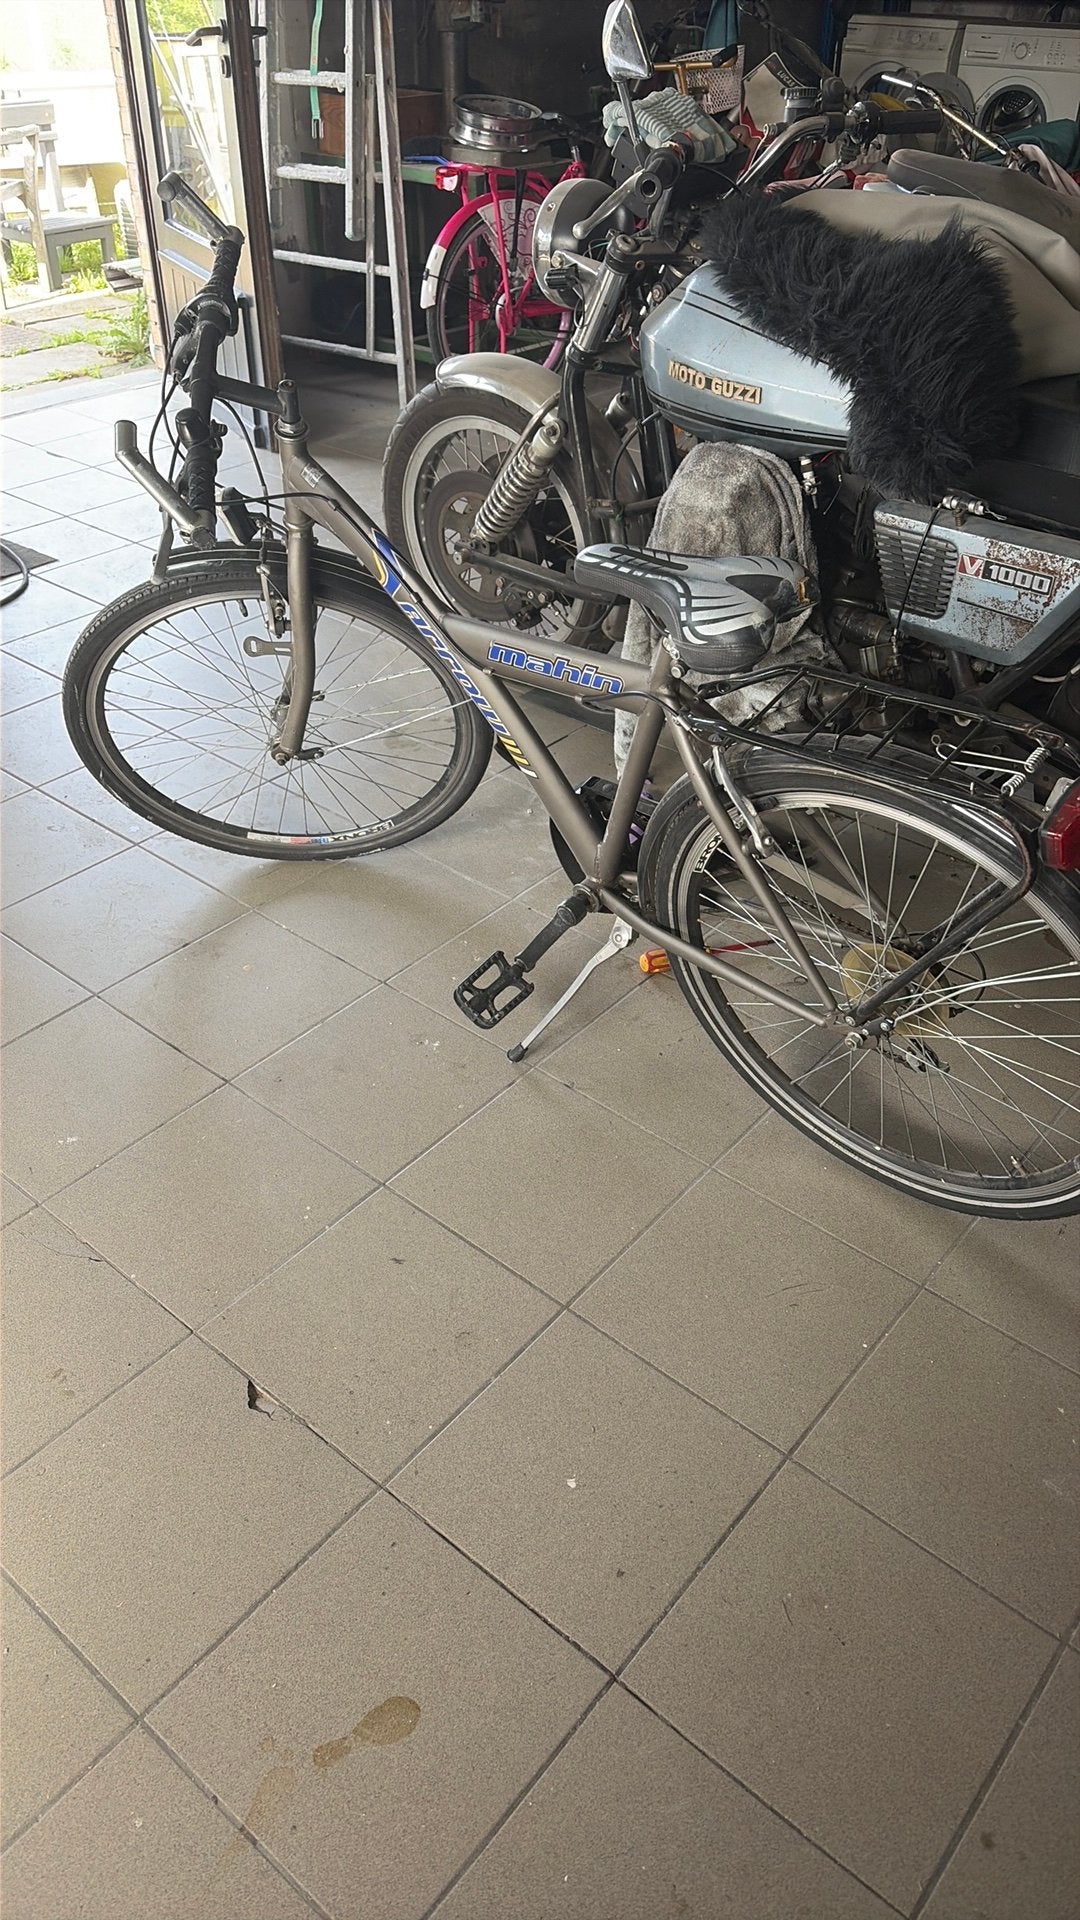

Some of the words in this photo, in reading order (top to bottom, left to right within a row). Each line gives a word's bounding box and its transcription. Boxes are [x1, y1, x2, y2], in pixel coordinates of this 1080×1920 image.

[668, 360, 706, 391] MOTO
[711, 378, 761, 405] GUZZI
[962, 554, 984, 575] V
[988, 564, 1051, 593] 1000
[487, 642, 624, 694] mahin
